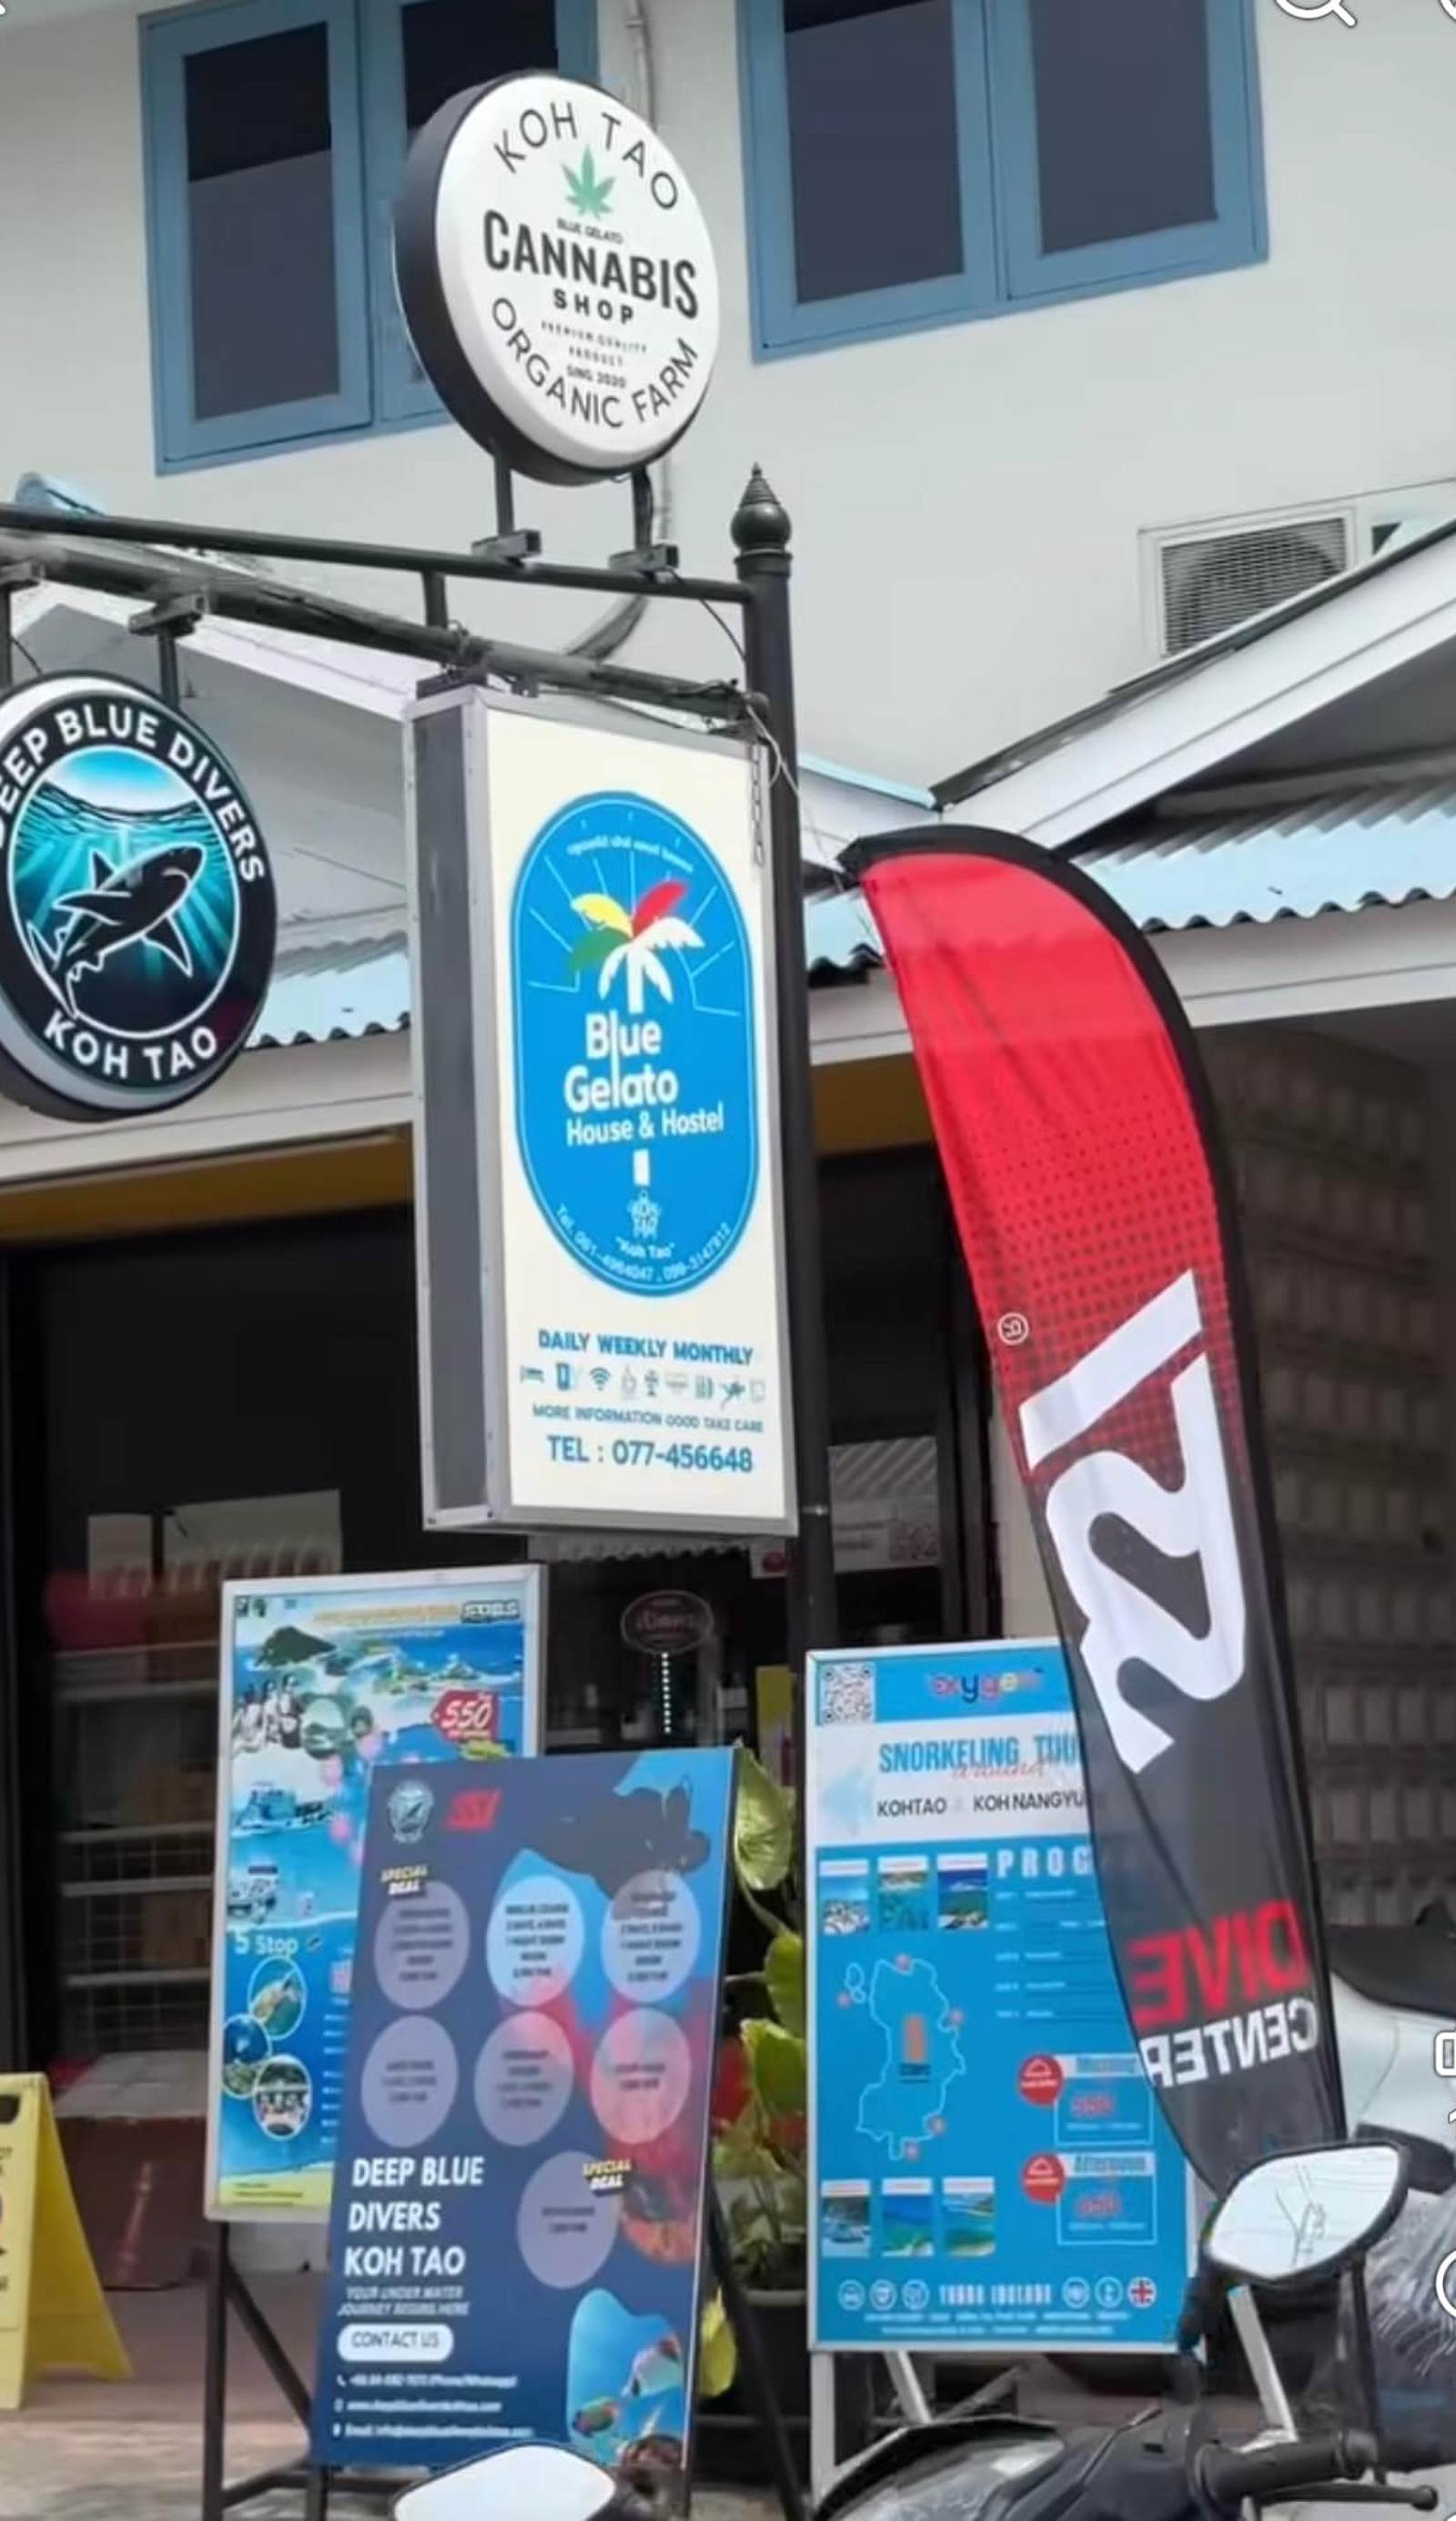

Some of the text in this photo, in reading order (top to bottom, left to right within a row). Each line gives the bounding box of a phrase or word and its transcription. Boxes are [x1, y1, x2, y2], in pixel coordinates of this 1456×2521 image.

[495, 102, 678, 210] KOH TAO
[484, 210, 698, 319] CANNABIS
[553, 288, 633, 327] SHOP
[493, 298, 698, 428] ORGANIC FARM
[56, 704, 159, 748] BLUE
[168, 732, 265, 883] DIVERS
[44, 1009, 217, 1081] KOH TAO
[585, 1009, 662, 1059] Blue
[563, 1063, 679, 1113] Gelato
[566, 1100, 724, 1147] House & Hostel
[538, 1329, 753, 1365] DAILY WEEKLY MONTHLY
[533, 1402, 571, 1420] MORE
[575, 1407, 662, 1426] INFORMATION
[665, 1412, 699, 1429] GOOD
[733, 1419, 763, 1433] CARE
[548, 1435, 590, 1463] TEL
[612, 1440, 753, 1473] 077-456648
[440, 1700, 493, 1729] 550
[878, 1736, 1019, 1774] SNORKELING
[877, 1797, 947, 1817] KOHTAO
[973, 1794, 1011, 1813] KOH
[234, 1931, 298, 1959] 5 Stop
[351, 2156, 484, 2187] DEEP BLUE
[348, 2202, 441, 2232] DIVERS
[343, 2246, 466, 2276] KOH TAO
[350, 2330, 440, 2349] CONTACT US
